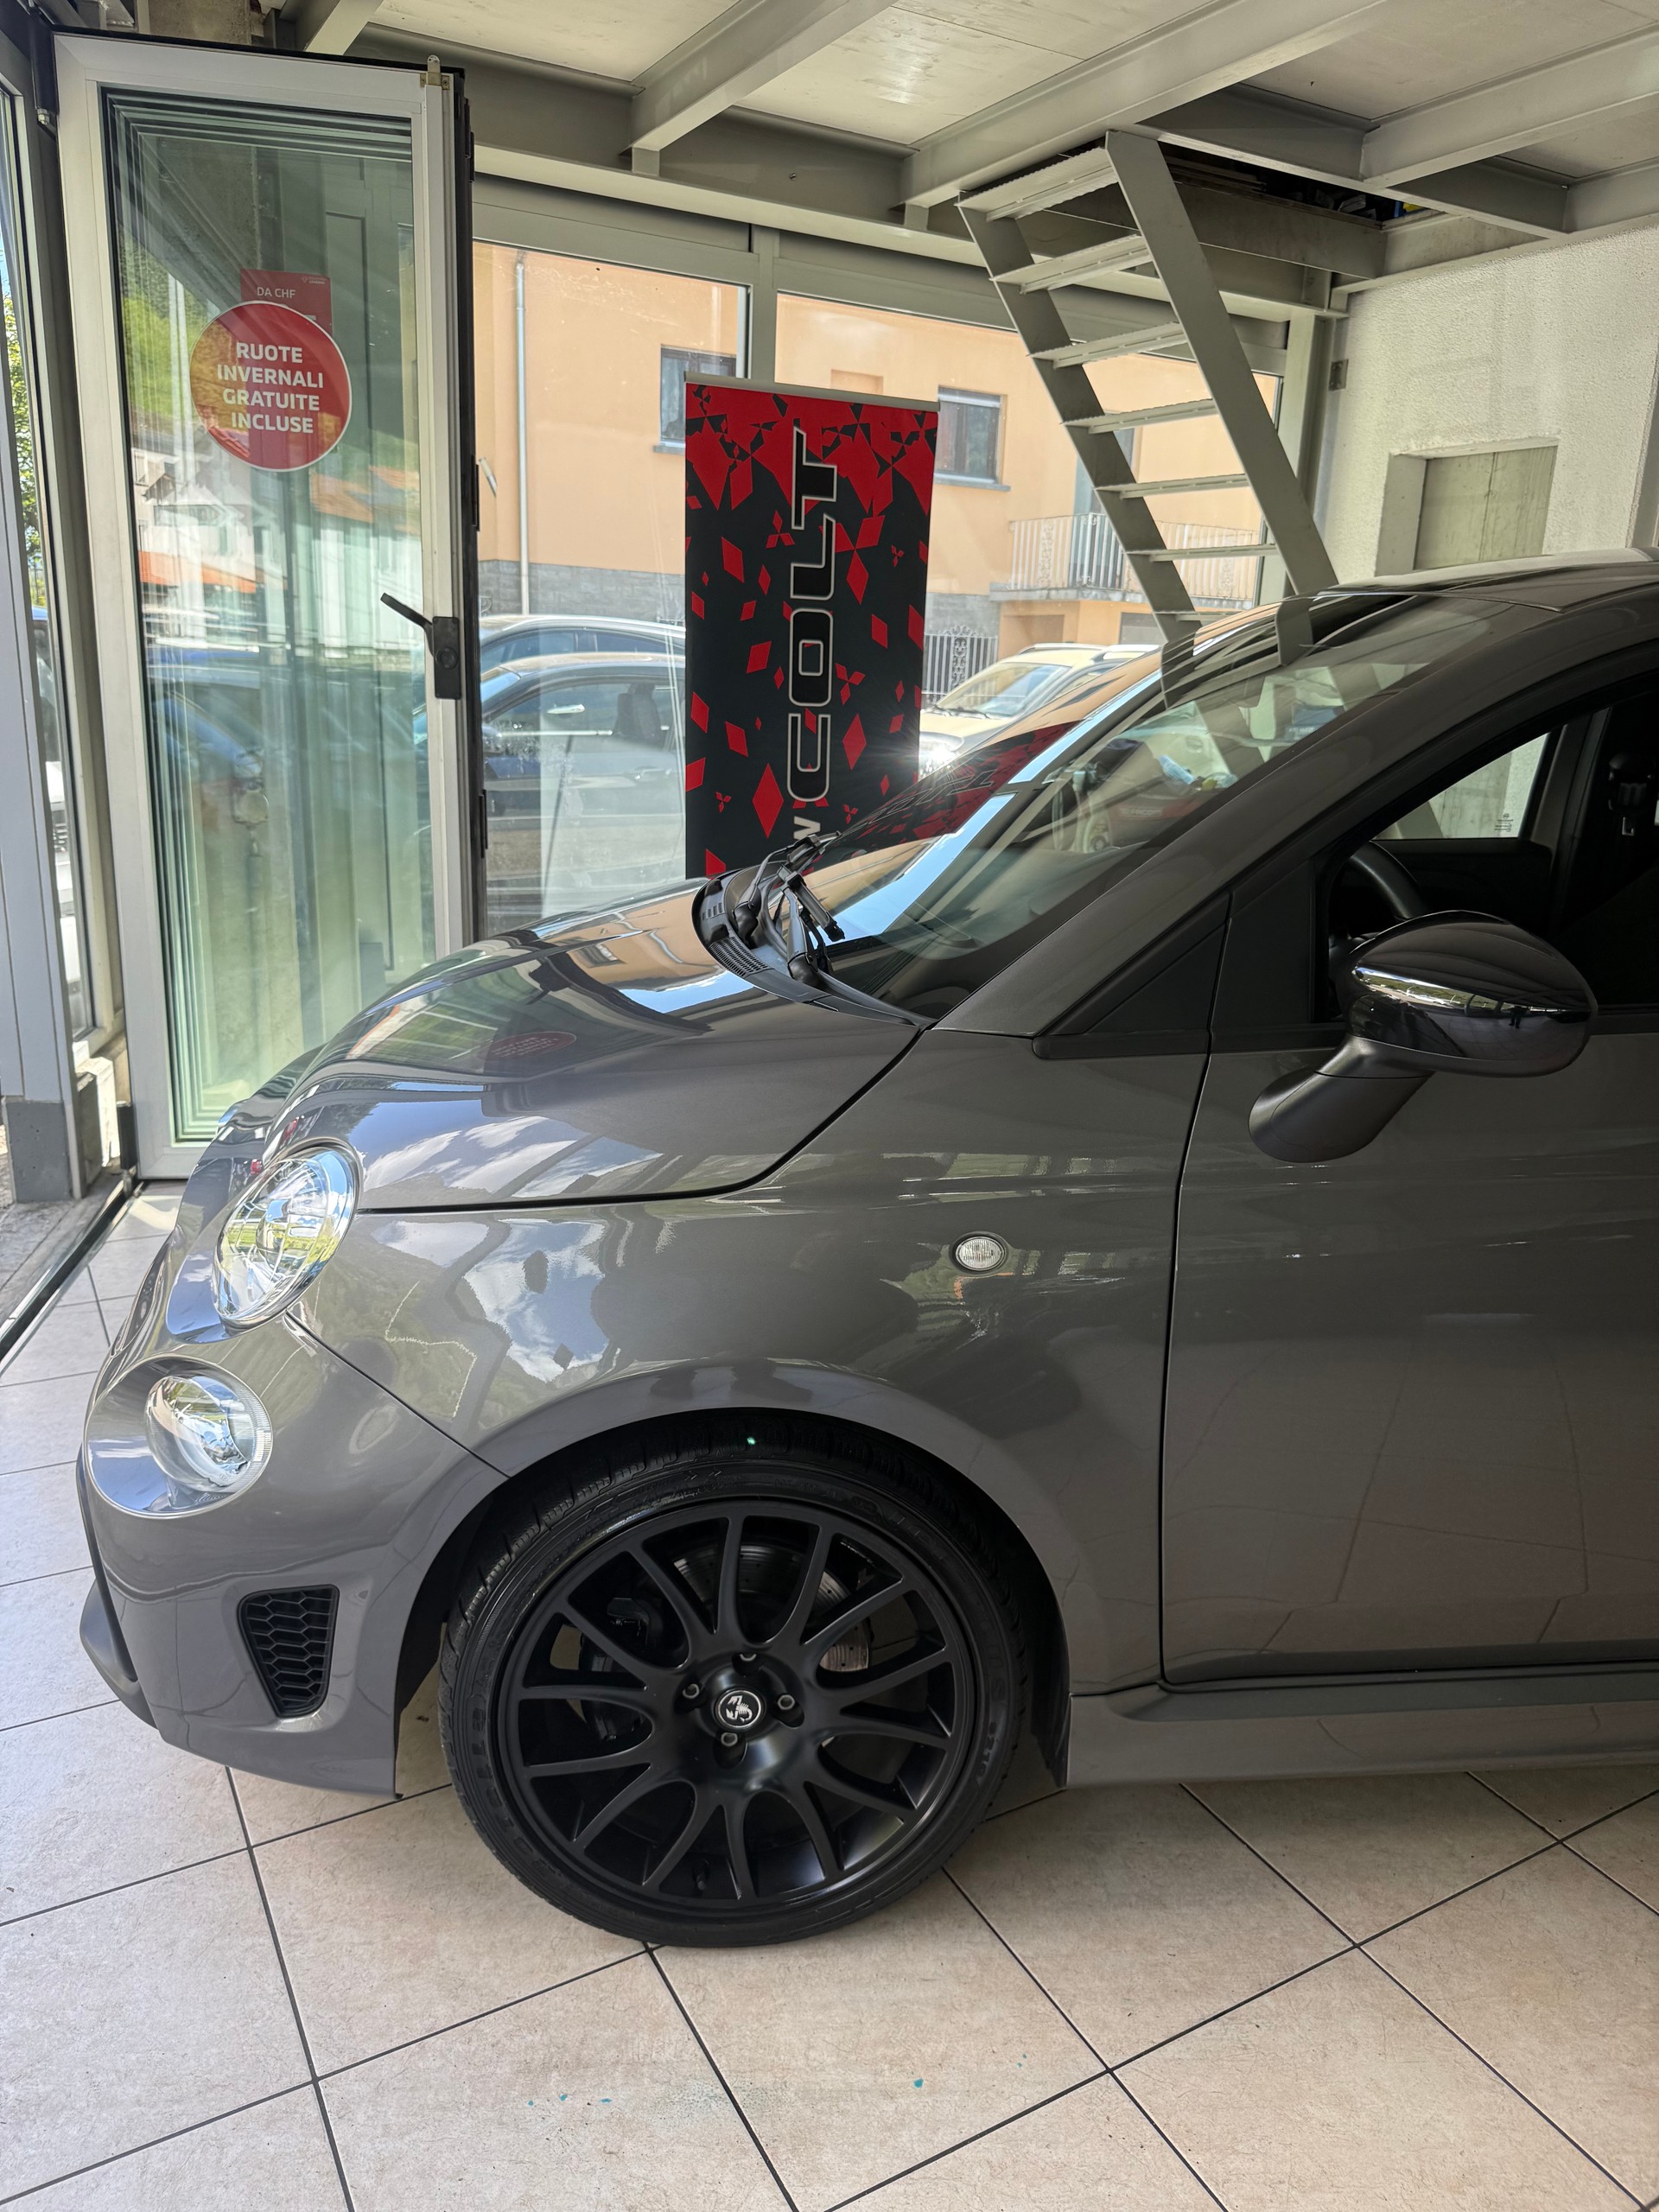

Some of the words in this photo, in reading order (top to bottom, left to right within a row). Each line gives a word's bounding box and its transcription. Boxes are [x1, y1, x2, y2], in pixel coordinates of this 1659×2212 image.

[257, 287, 272, 296] DA
[275, 288, 296, 298] CHF
[236, 342, 303, 363] RUOTE
[217, 364, 324, 388] INVERNALI
[223, 389, 320, 411] GRATUITE
[232, 412, 314, 434] INCLUSE
[787, 427, 837, 802] COLT
